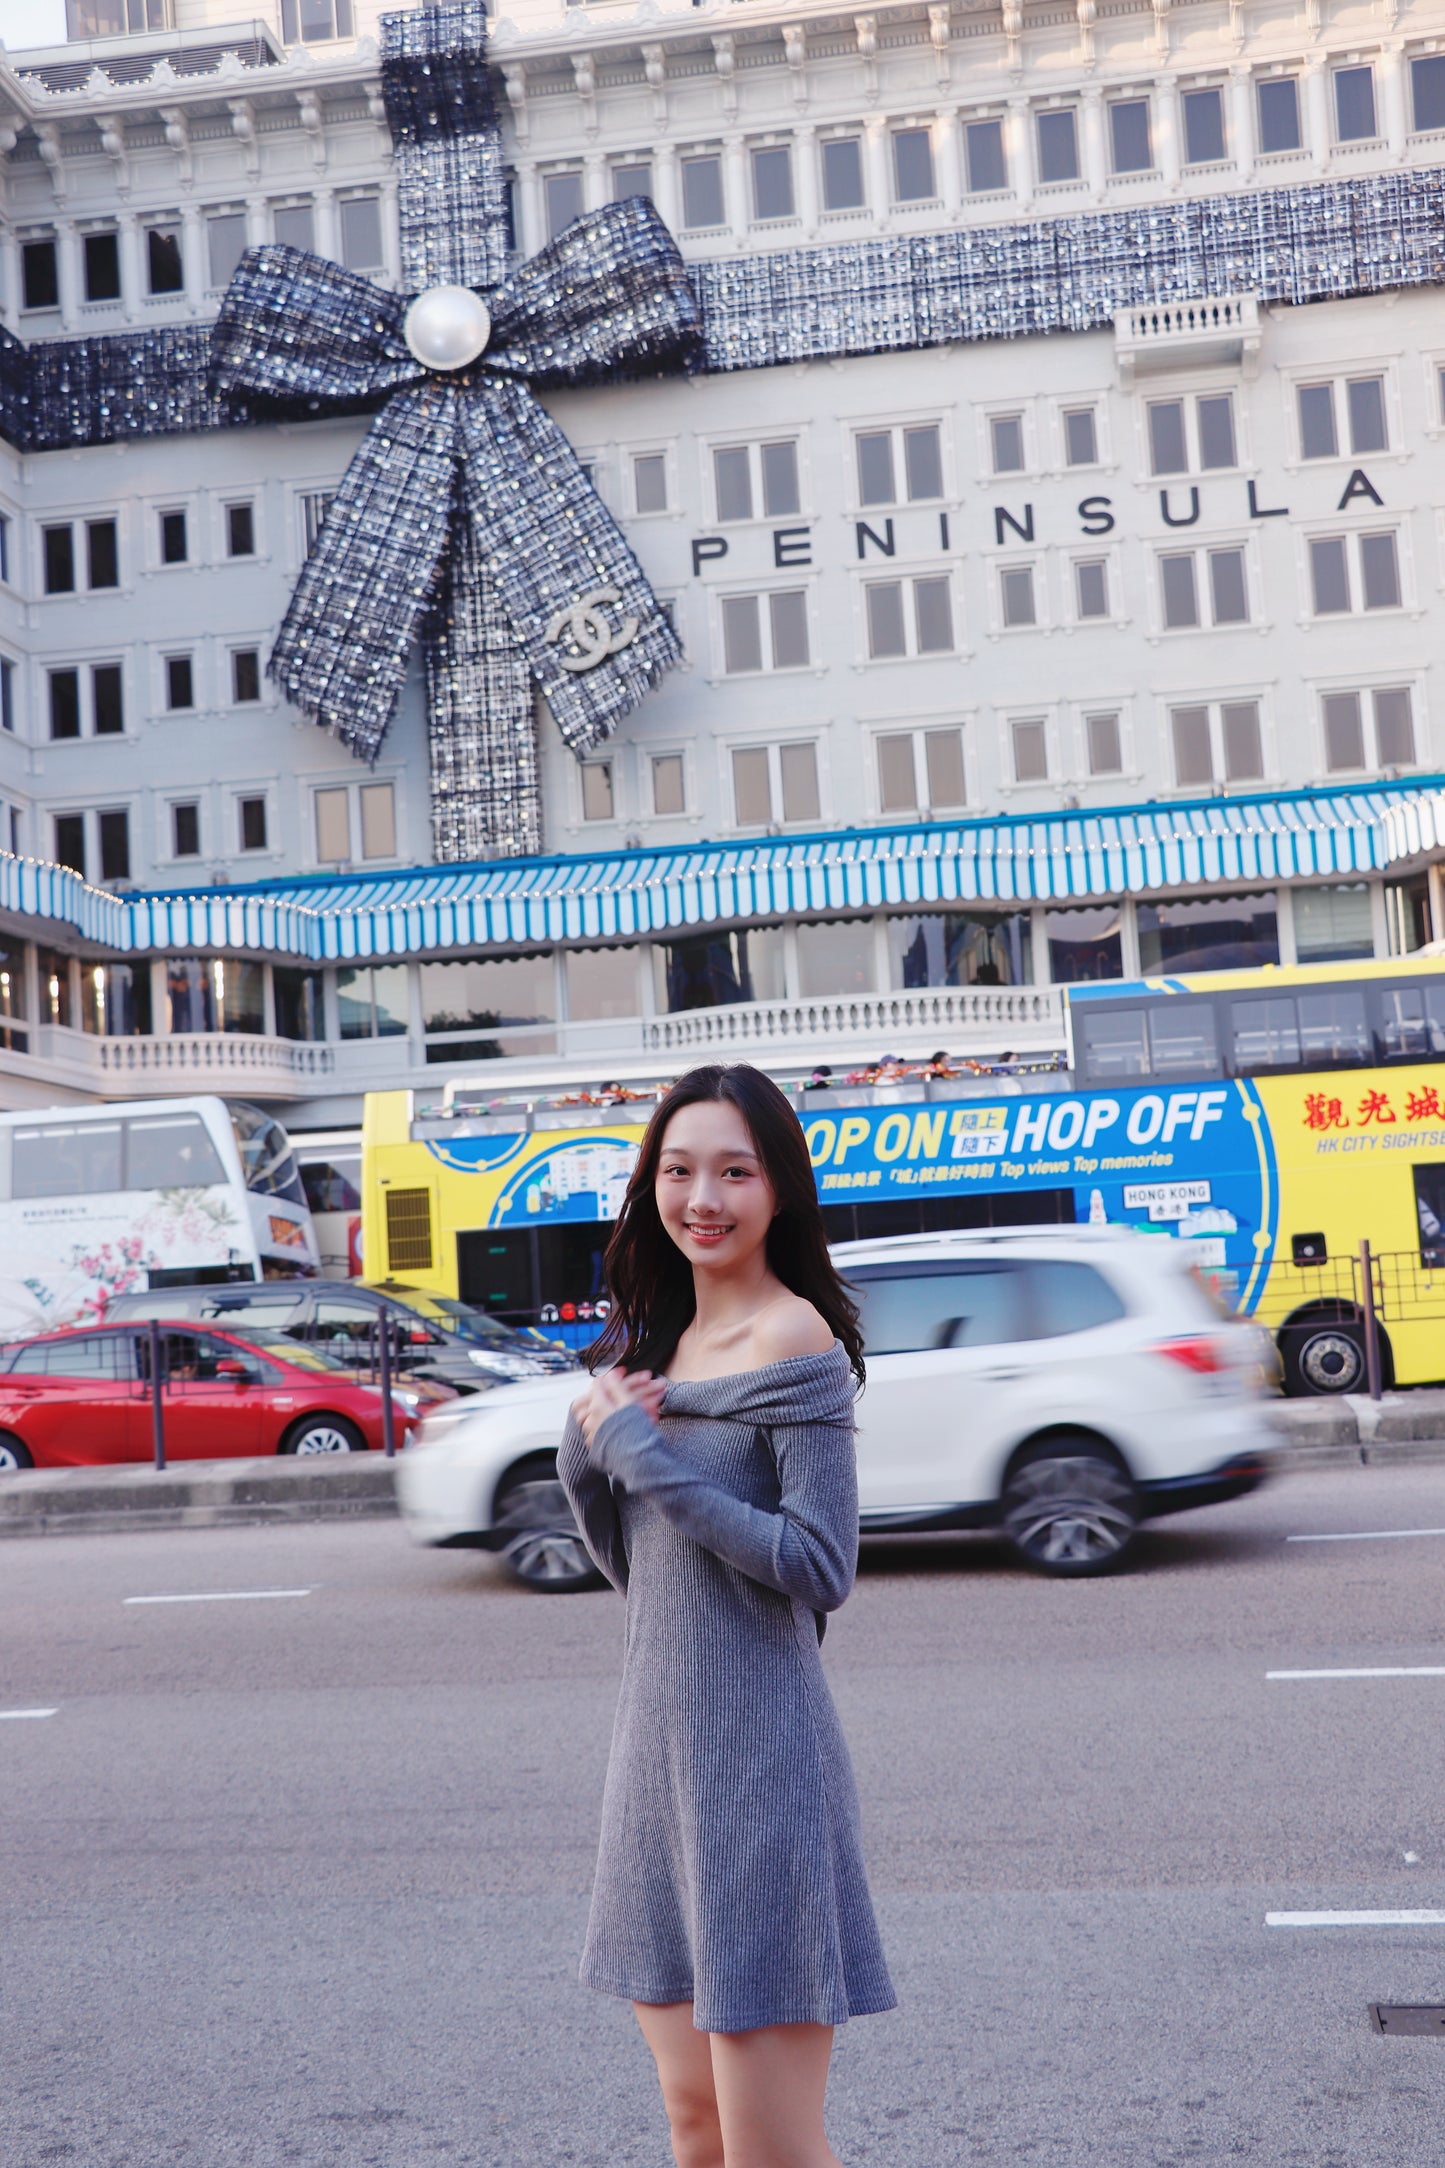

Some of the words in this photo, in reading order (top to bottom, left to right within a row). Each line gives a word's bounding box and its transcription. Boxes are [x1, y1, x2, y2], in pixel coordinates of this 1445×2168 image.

[691, 469, 1385, 577] PENINSULA
[960, 1112, 998, 1131] 隨上
[1010, 1098, 1121, 1153] HOP
[1126, 1090, 1228, 1145] OFF
[1303, 1085, 1445, 1131] 觀光城
[800, 1117, 871, 1169] OP
[873, 1112, 948, 1163] ON
[960, 1135, 1000, 1154] 隨下
[1316, 1137, 1340, 1153] HK
[1342, 1134, 1379, 1152] CITY
[1000, 1161, 1025, 1179] Top
[1028, 1159, 1070, 1175] views
[1073, 1156, 1098, 1174] Top
[1100, 1151, 1174, 1170] memories
[1128, 1187, 1166, 1203] HONG
[1169, 1185, 1206, 1199] KONG
